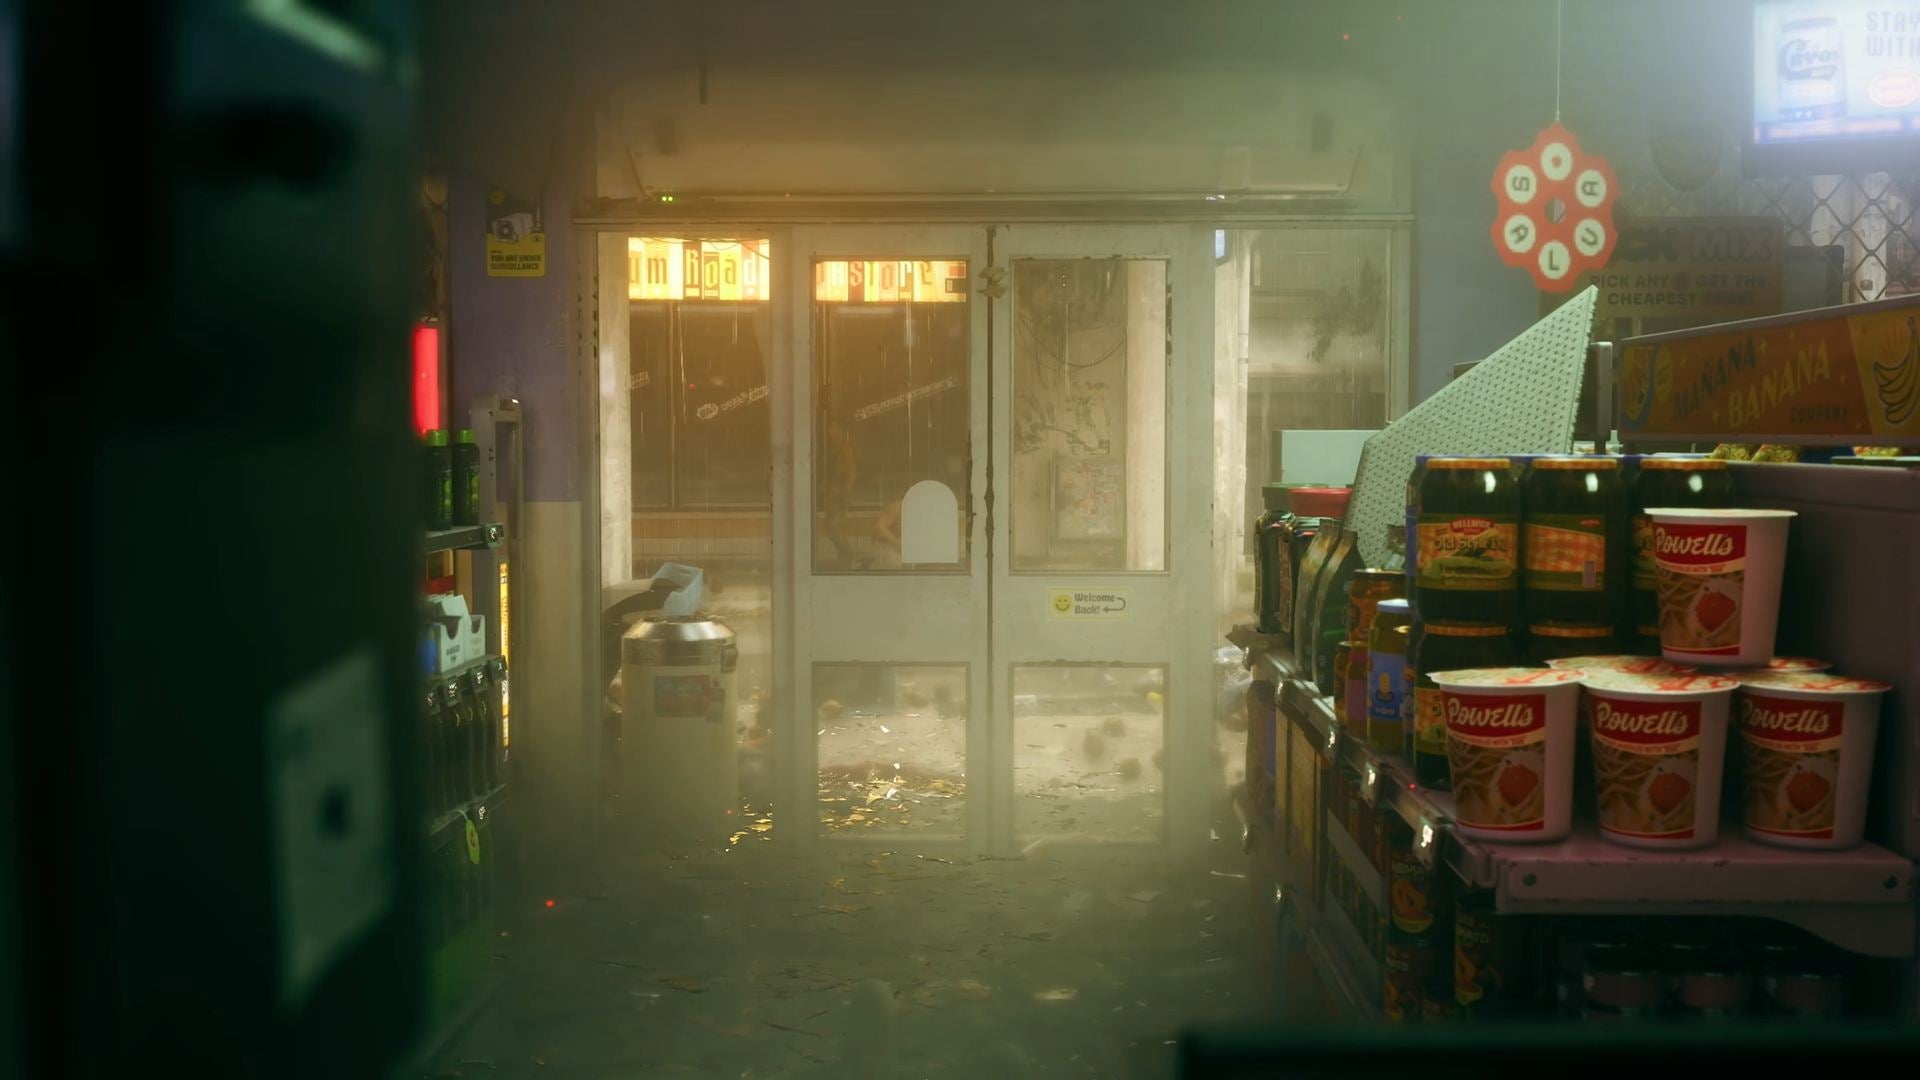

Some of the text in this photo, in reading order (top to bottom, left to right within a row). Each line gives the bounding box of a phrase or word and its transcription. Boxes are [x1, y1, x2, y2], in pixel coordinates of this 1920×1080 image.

[685, 248, 759, 288] Road
[1635, 275, 1670, 287] ANY
[1696, 275, 1729, 287] GET
[1734, 274, 1768, 287] THE
[1607, 292, 1698, 306] CHEAPEST
[1728, 339, 1831, 430] BANANA
[1791, 404, 1849, 424] COMPANY
[1655, 527, 1734, 556] Powell's
[1074, 593, 1115, 602] Welcome
[1074, 605, 1101, 615] Back!
[1447, 696, 1535, 727] Powell's
[1596, 701, 1689, 734] Powell's
[1743, 698, 1830, 734] Powell's
